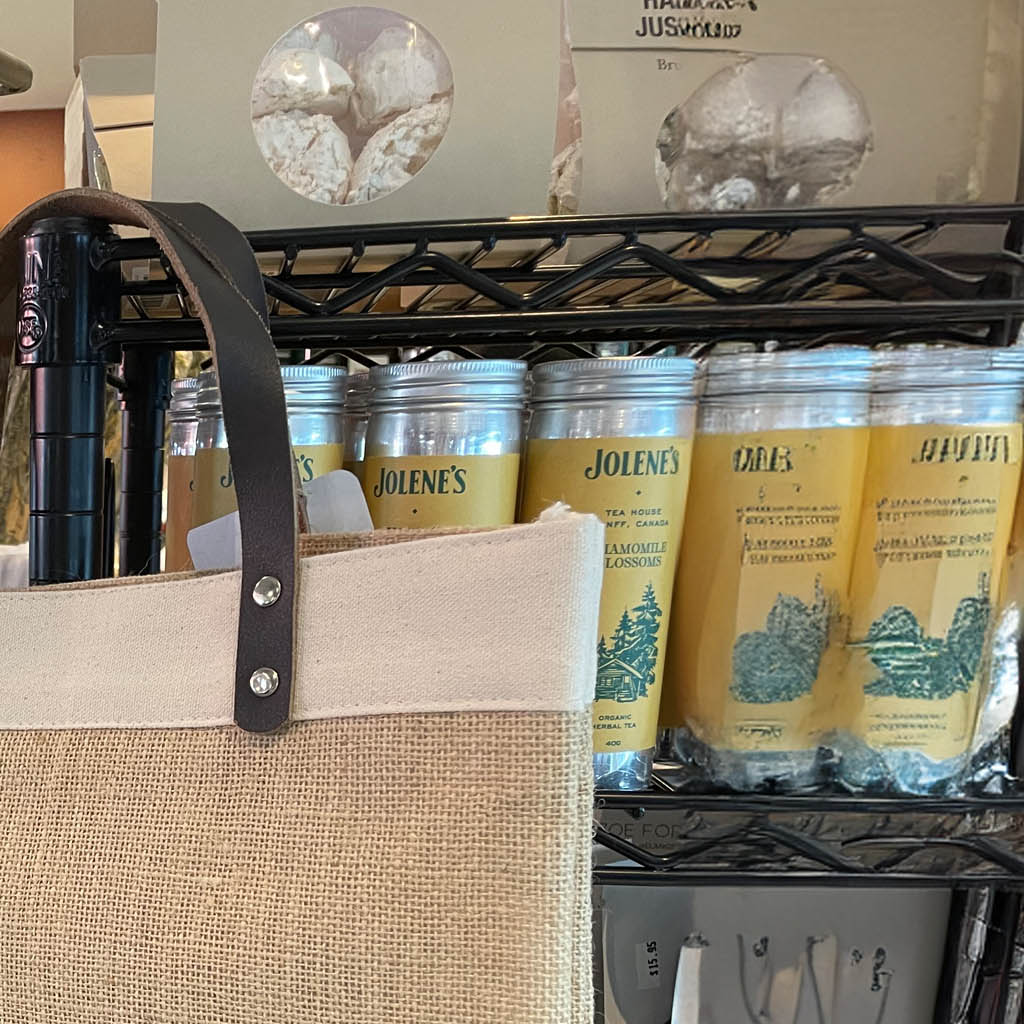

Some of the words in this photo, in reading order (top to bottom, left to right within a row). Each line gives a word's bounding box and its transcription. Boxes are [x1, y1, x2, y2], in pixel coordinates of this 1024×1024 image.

[584, 446, 680, 480] JOLENE'S
[374, 465, 467, 498] JOLENE'S
[605, 509, 625, 517] TEA
[631, 508, 662, 516] HOUSE
[606, 521, 630, 529] NFF,
[636, 520, 669, 528] CANADA
[606, 541, 667, 555] AMOMILE
[605, 556, 662, 569] LOSSOMS
[646, 940, 659, 977] $15.95
